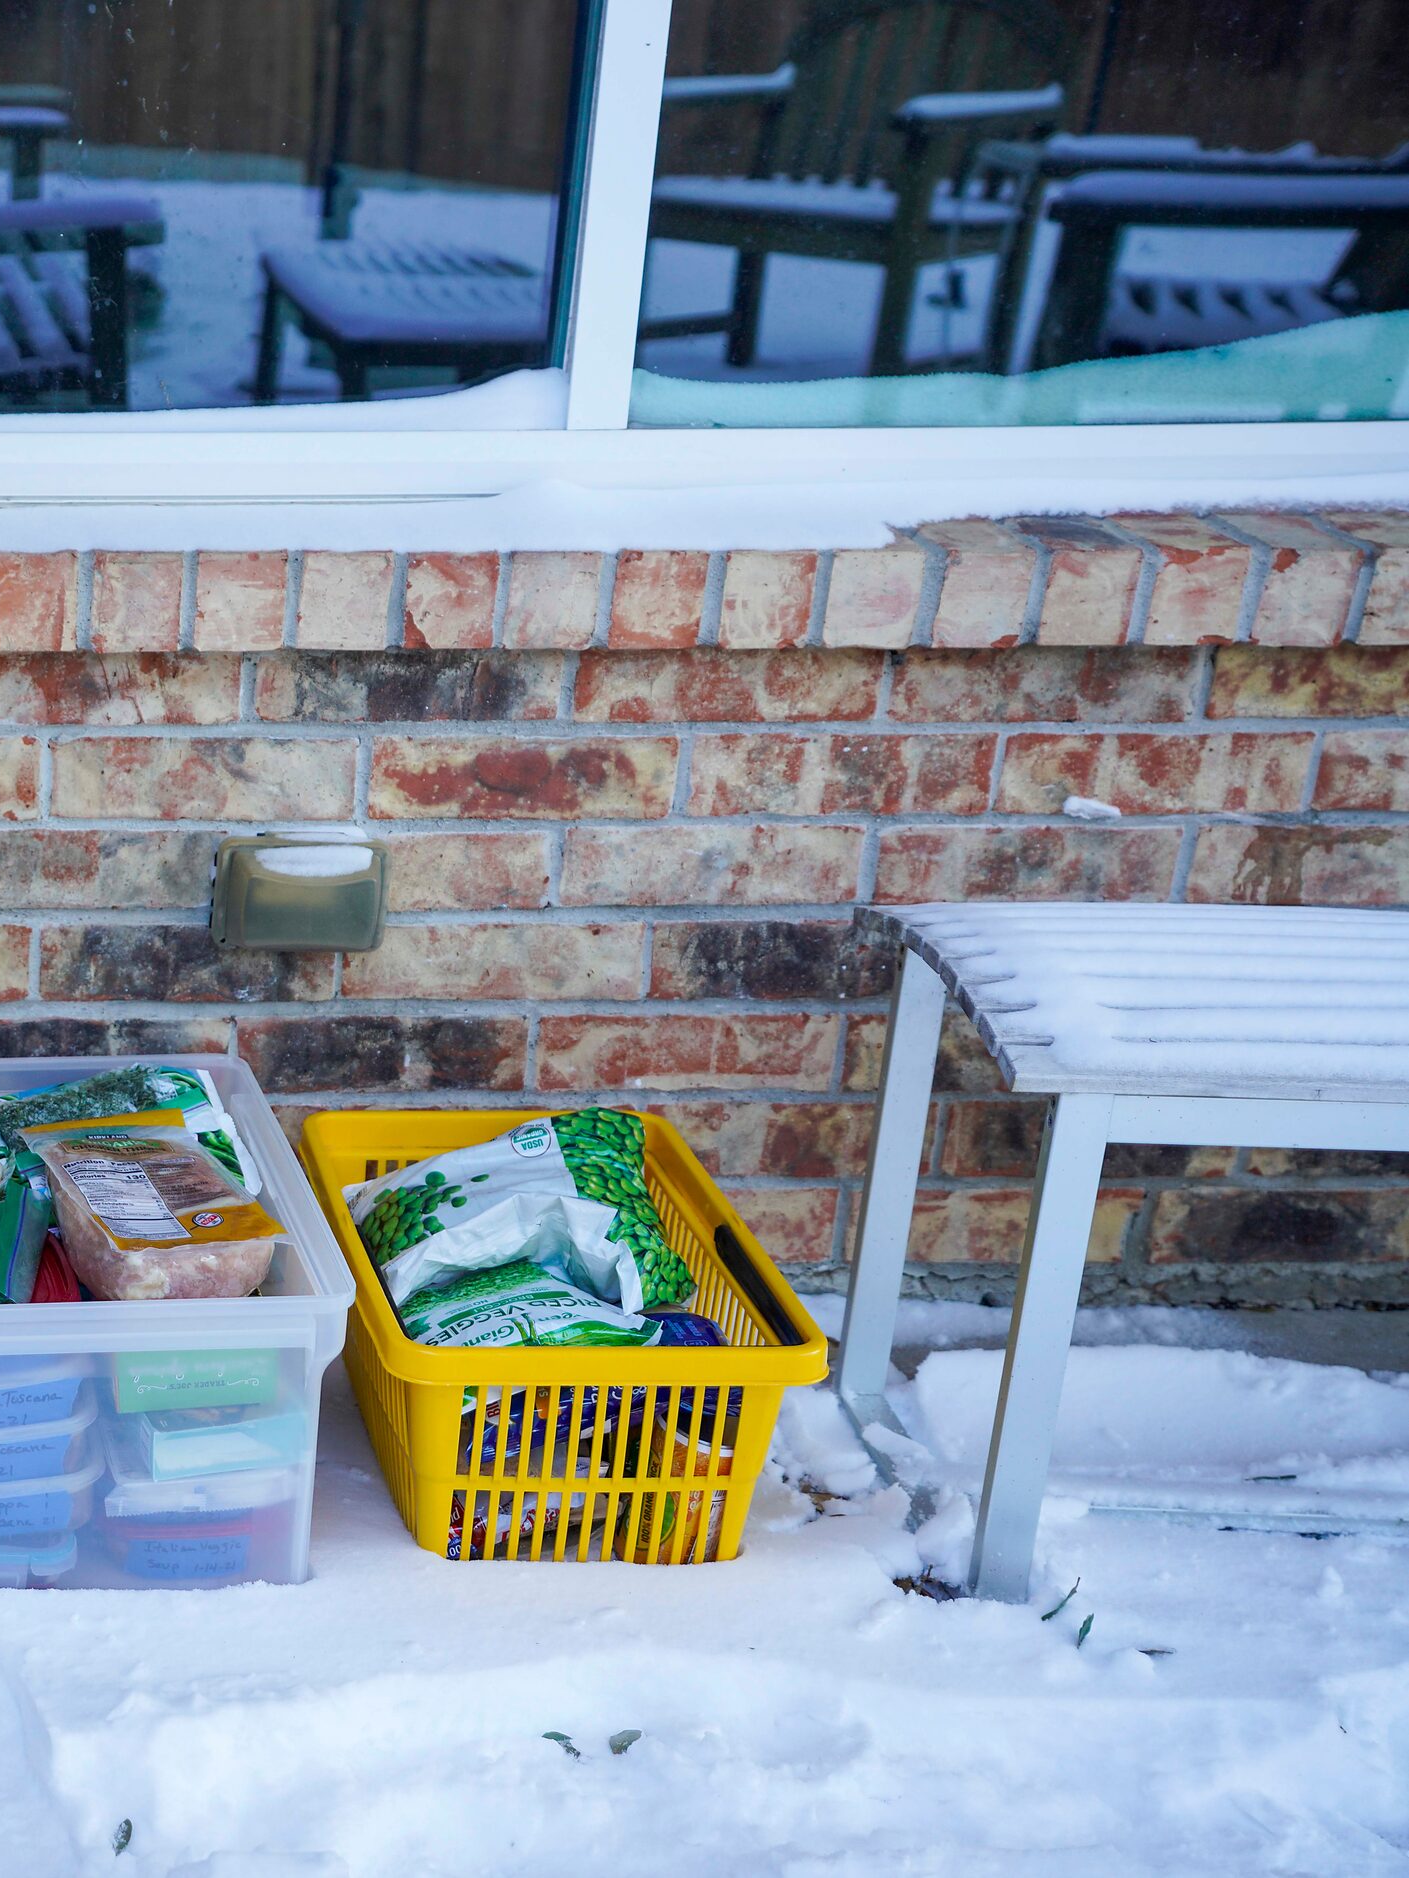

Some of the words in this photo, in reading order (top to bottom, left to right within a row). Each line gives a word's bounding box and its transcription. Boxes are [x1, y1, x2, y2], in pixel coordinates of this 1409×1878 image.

[521, 1138, 544, 1150] USDA
[63, 1159, 105, 1169] Nutrition
[471, 1293, 534, 1313] BROCCOLI
[528, 1299, 603, 1309] RICED
[426, 1304, 526, 1346] VEGGIES
[194, 1380, 226, 1388] TRADER
[643, 1491, 656, 1521] ORANG
[143, 1540, 197, 1554] Italian
[199, 1541, 242, 1555] Veggie
[146, 1558, 180, 1574] Soup
